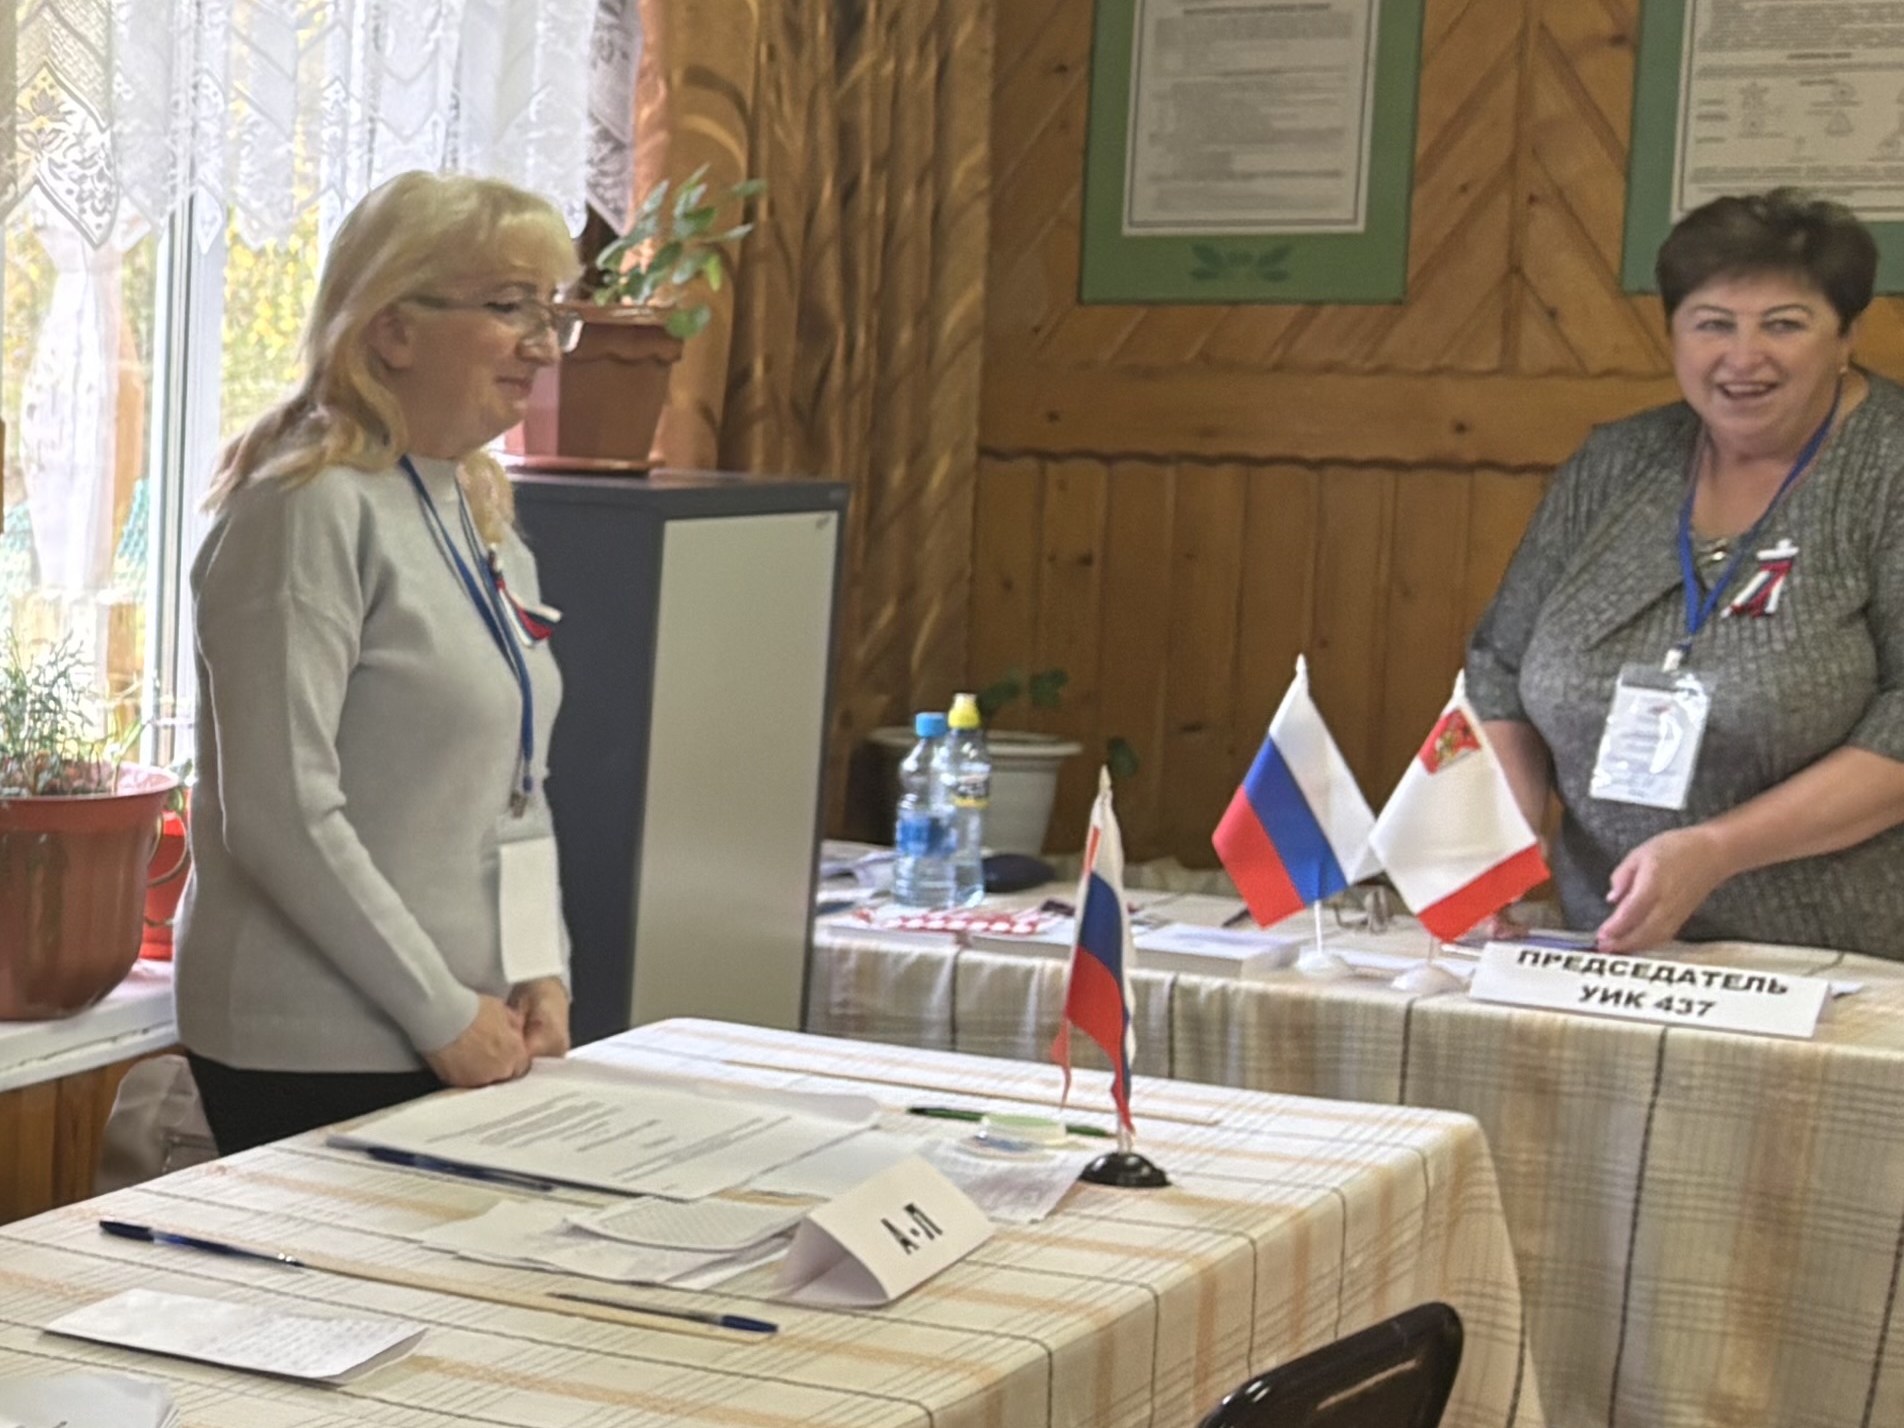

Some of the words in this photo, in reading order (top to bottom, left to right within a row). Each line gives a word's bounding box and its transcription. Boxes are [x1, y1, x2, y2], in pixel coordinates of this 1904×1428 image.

[1517, 949, 1789, 995] ПРЕДСЕДАТЕЛЬ
[1578, 985, 1643, 1010] УИК
[1653, 993, 1718, 1018] 437
